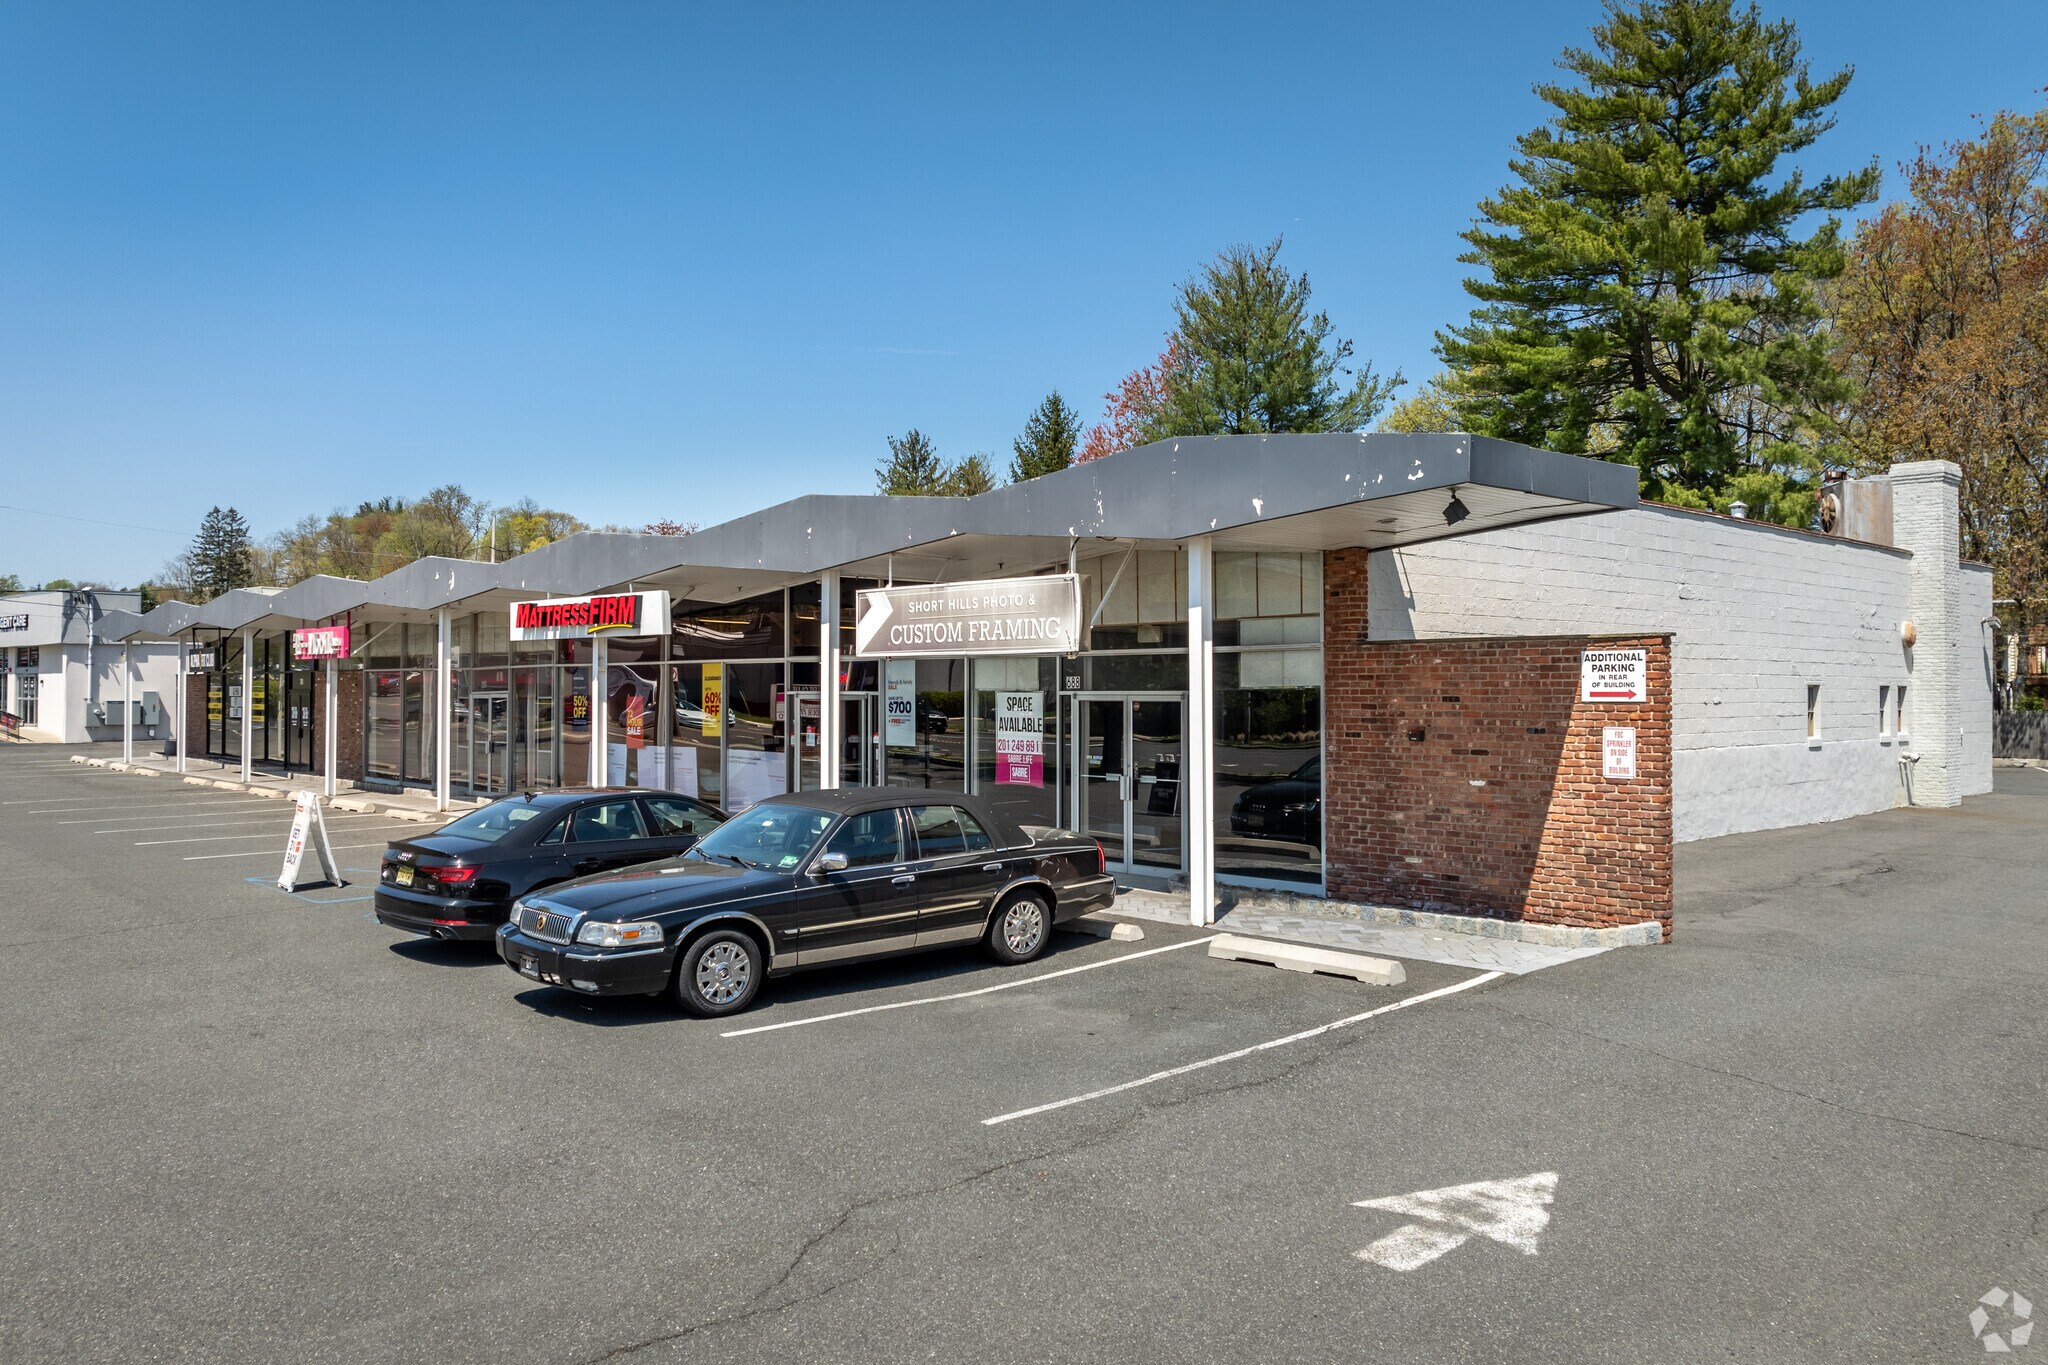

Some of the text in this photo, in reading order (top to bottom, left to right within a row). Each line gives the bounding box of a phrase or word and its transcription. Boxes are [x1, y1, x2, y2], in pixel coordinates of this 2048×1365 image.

[908, 594, 1036, 613] SHORT HILLS PHOTO &
[13, 614, 28, 628] CARE
[890, 616, 1061, 645] CUSTOM FRAMING
[1584, 653, 1643, 662] ADDITIONAL
[1592, 664, 1635, 672] PARKING
[1067, 677, 1080, 688] 688
[573, 695, 588, 707] 50%
[704, 692, 721, 704] 60%
[1006, 696, 1033, 712] SPACE
[573, 707, 587, 719] OFF
[704, 704, 720, 717] OFF
[888, 701, 912, 714] $700
[626, 726, 641, 735] SALE
[998, 717, 1043, 733] AVAILABLE
[998, 739, 1010, 751] 201
[1011, 739, 1025, 752] 249
[1607, 739, 1631, 748] SPRINKLER
[1618, 749, 1628, 757] SIDE
[1011, 766, 1028, 777] SABRE
[1609, 766, 1630, 774] BUILDING
